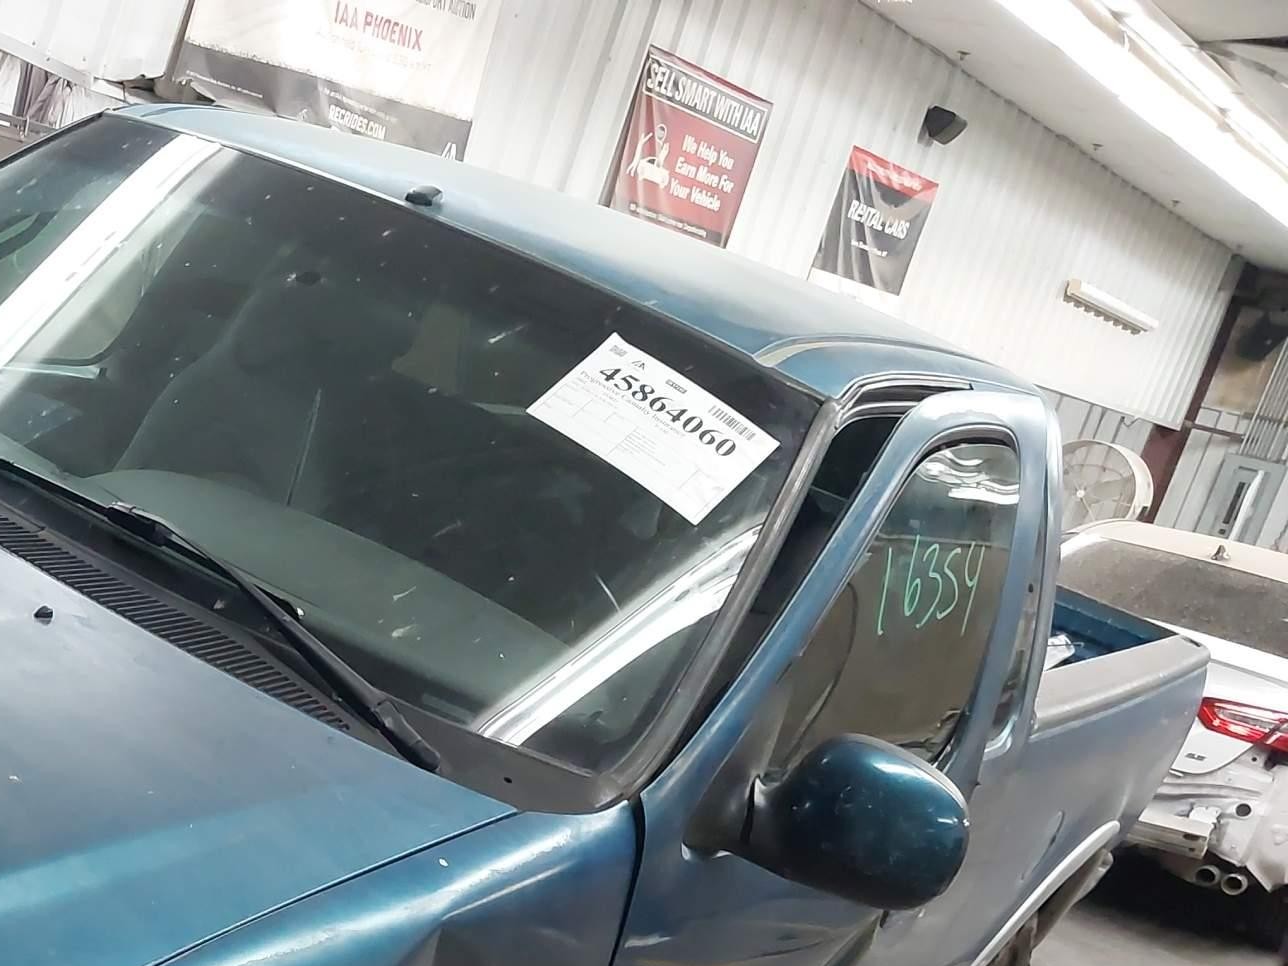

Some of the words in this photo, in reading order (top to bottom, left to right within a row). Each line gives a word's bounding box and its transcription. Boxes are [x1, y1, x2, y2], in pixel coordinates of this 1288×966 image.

[334, 0, 360, 29] IAA
[362, 11, 424, 51] PHOENIX
[646, 62, 675, 97] SELL
[675, 75, 717, 115] SMART
[714, 92, 743, 128] WITH
[740, 106, 762, 136] IAA
[328, 104, 387, 141] RECRIDES.COM
[682, 134, 698, 156] We
[697, 140, 718, 165] Help
[716, 147, 735, 170] You
[674, 156, 696, 179] Earn
[696, 164, 720, 188] More
[718, 174, 735, 193] For
[669, 178, 690, 200] Your
[689, 185, 721, 212] Vehicle
[884, 219, 910, 240] CARS
[599, 367, 737, 457] 45864060
[877, 535, 986, 637] 16354
